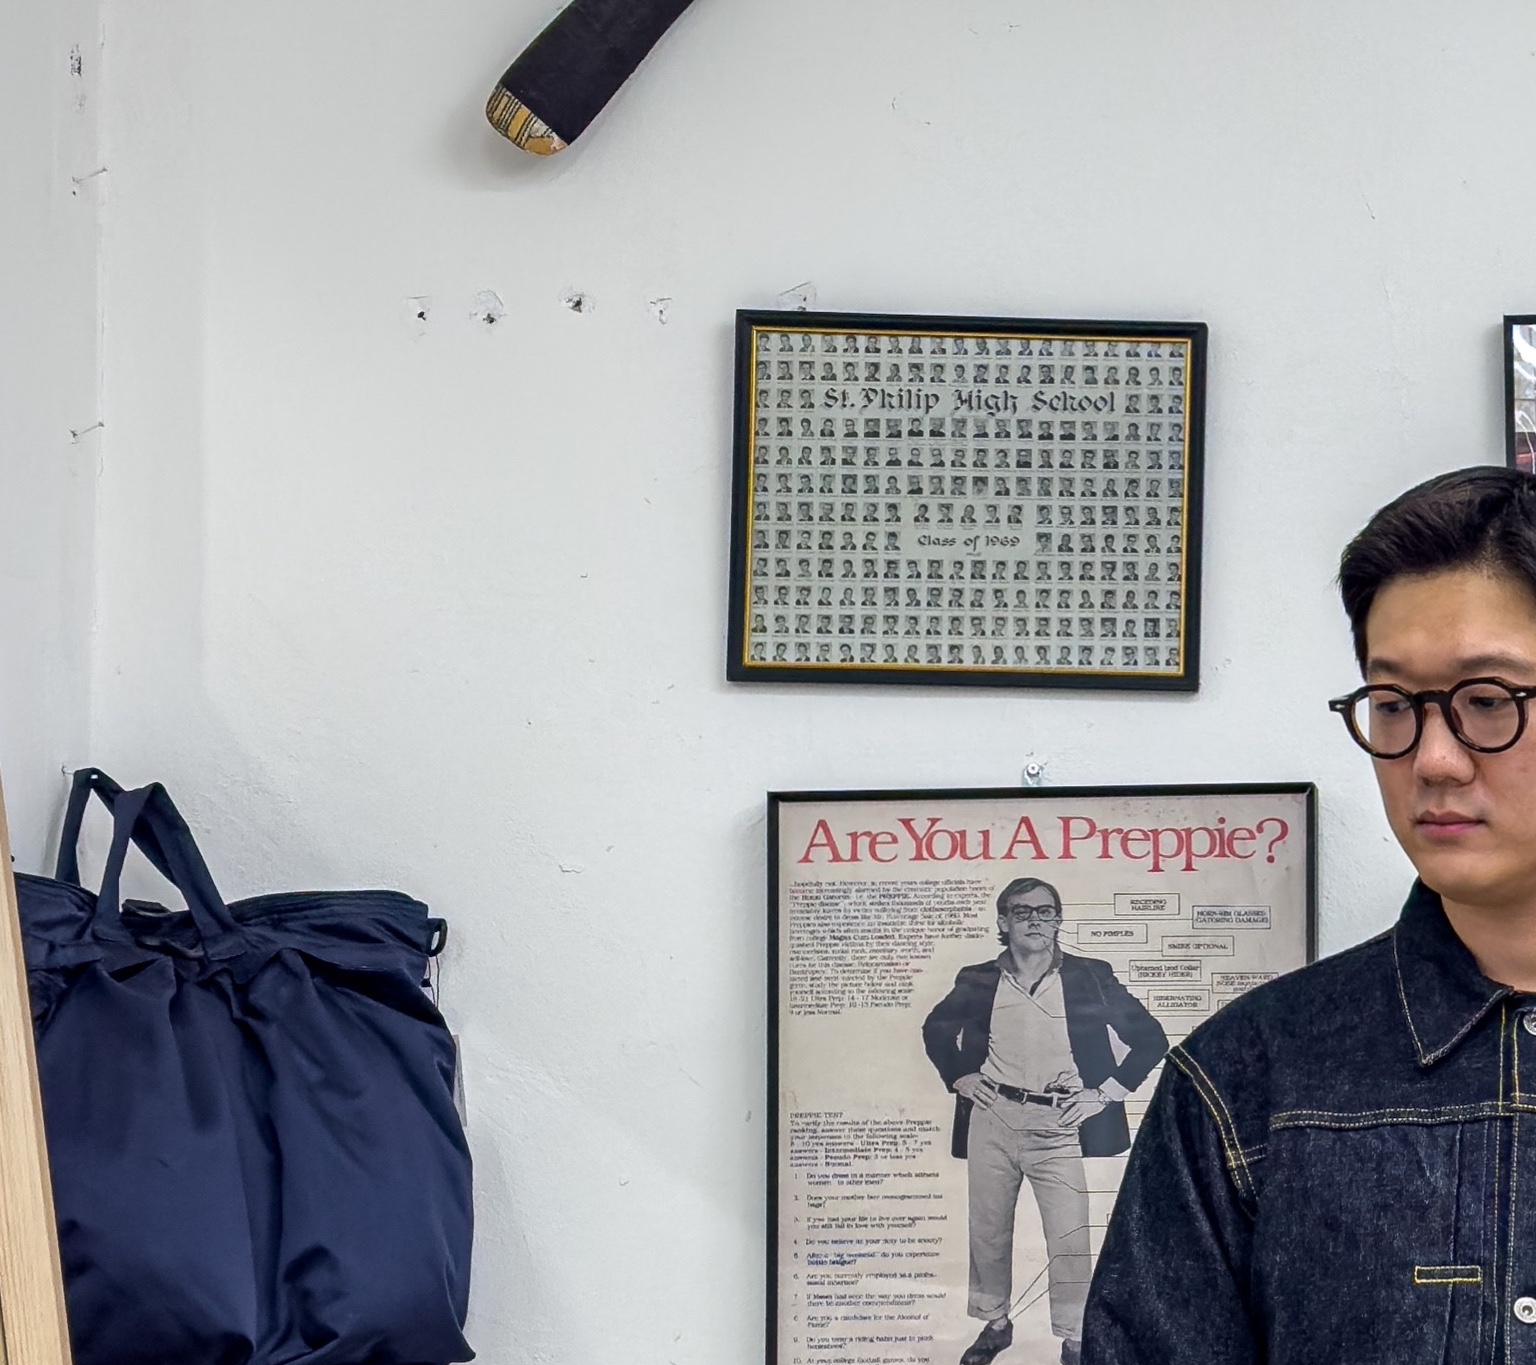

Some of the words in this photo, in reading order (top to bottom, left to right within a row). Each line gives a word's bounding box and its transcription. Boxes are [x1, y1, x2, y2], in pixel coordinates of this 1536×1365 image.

[823, 387, 854, 409] St.
[859, 387, 941, 415] Philip
[952, 389, 1018, 417] High
[1031, 390, 1116, 413] School
[917, 534, 957, 547] Class
[963, 535, 980, 552] of
[984, 535, 1021, 548] 1969
[797, 818, 899, 864] Are
[897, 817, 997, 861] You
[1000, 815, 1049, 860] A
[1057, 816, 1290, 873] Preppie?
